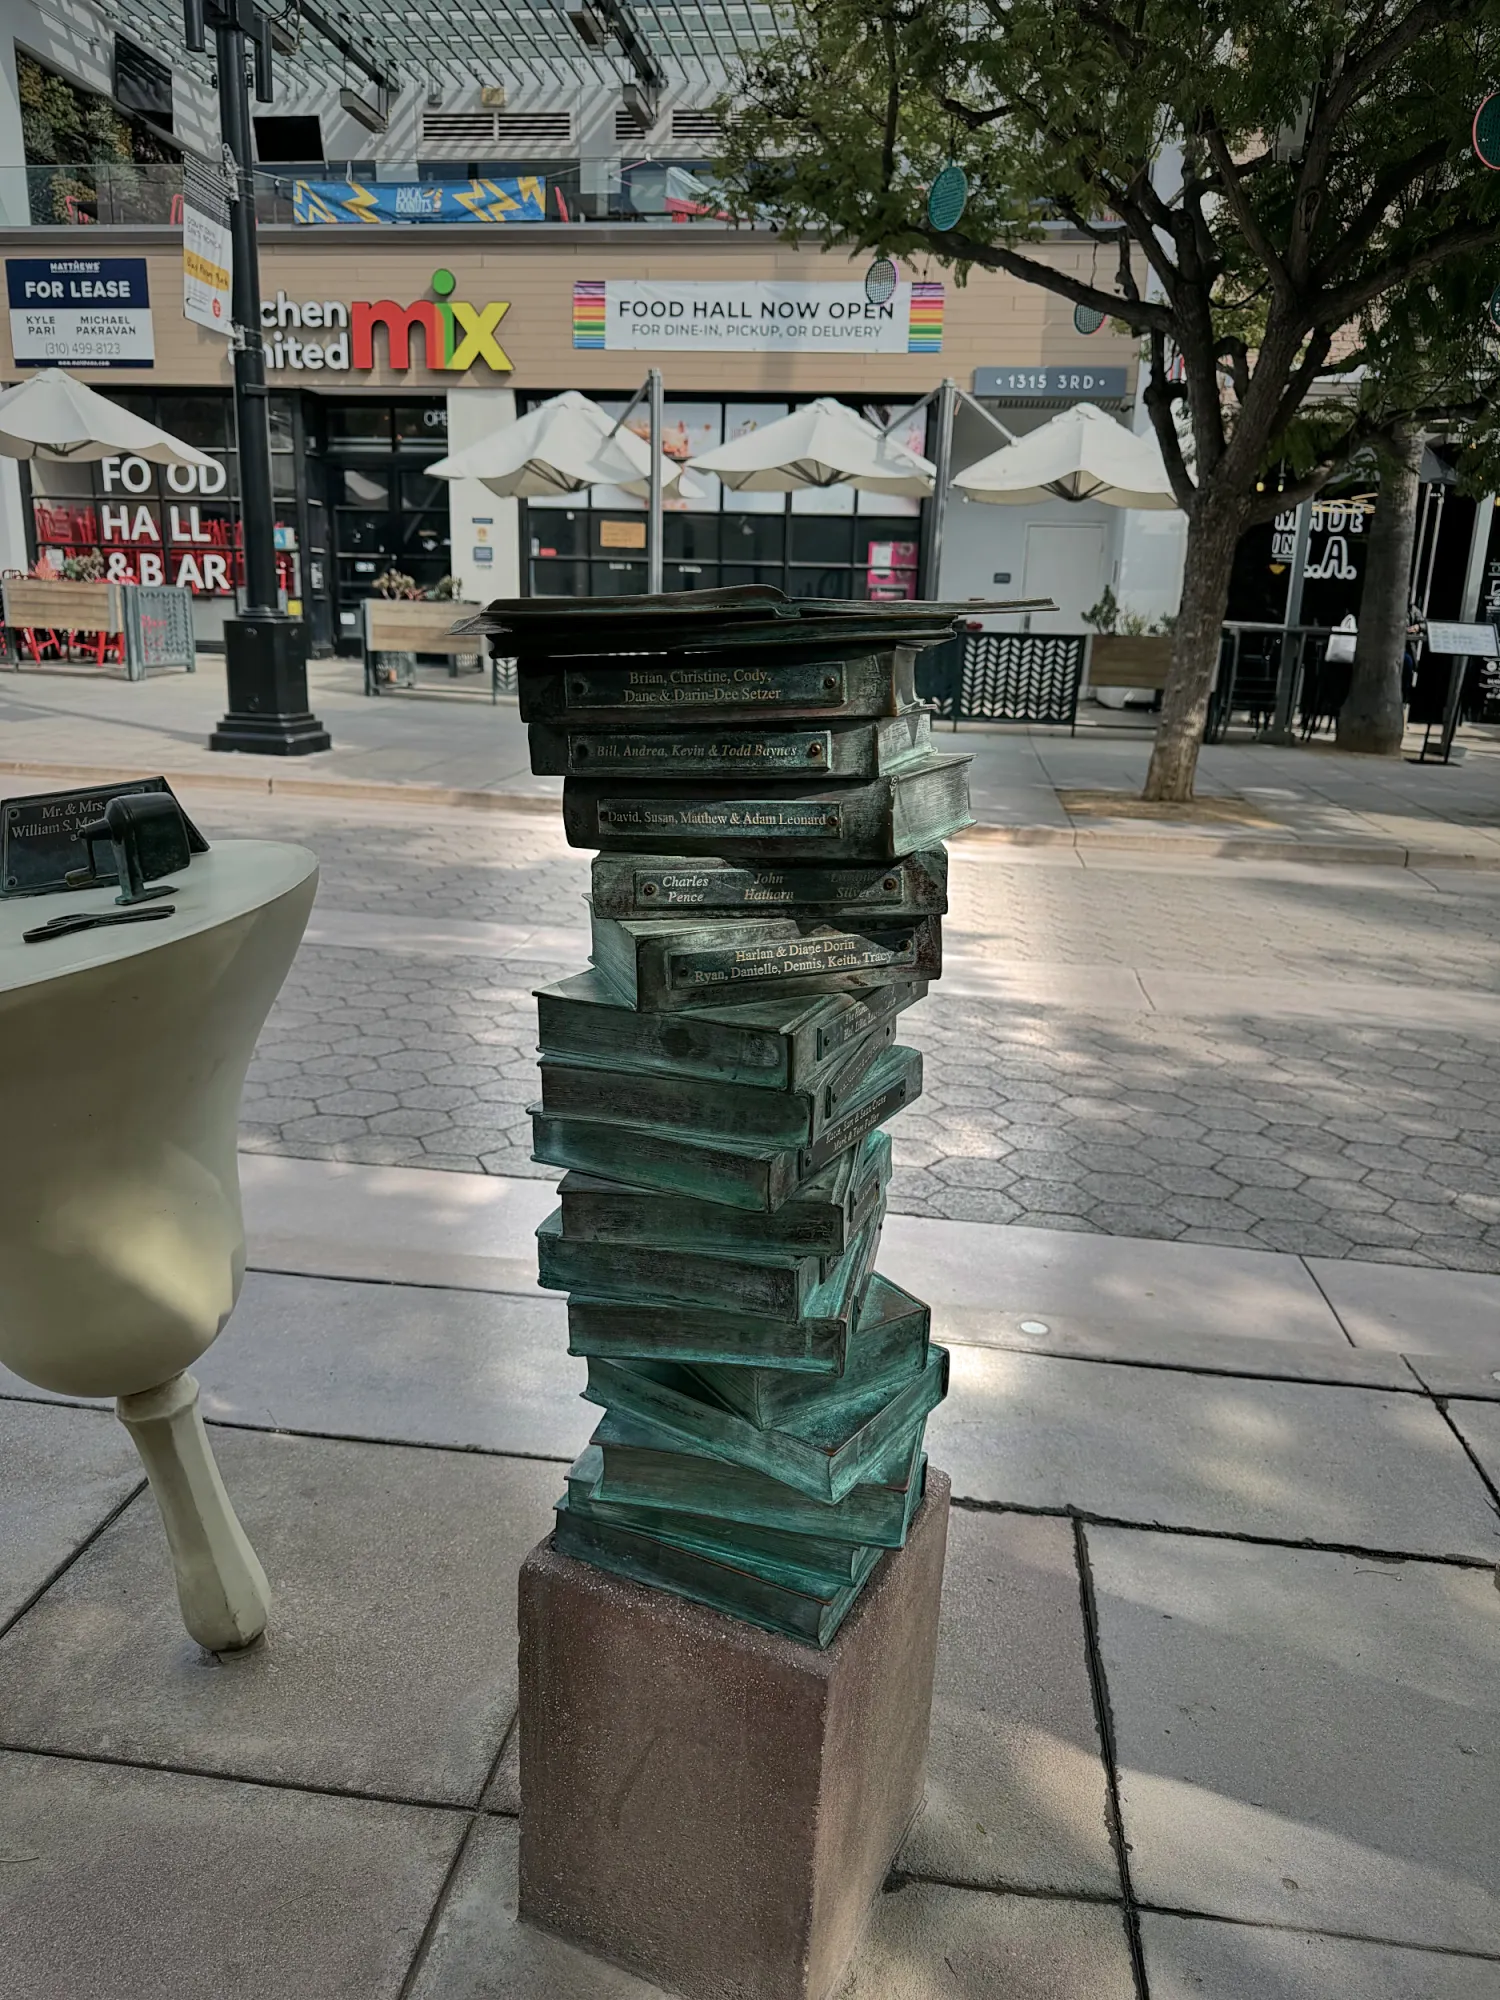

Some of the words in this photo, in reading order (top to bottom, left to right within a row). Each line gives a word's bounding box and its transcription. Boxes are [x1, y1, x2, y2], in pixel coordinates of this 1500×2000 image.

[396, 187, 422, 199] DUCK
[25, 281, 64, 298] FOR
[70, 281, 131, 298] LEASE
[259, 290, 349, 328] chen
[619, 301, 684, 318] FOOD
[693, 301, 752, 319] HALL
[761, 302, 820, 319] NOW
[829, 302, 894, 319] OPEN
[26, 316, 56, 324] KYLE
[80, 316, 131, 325] MICHAEL
[351, 268, 514, 371] mix
[28, 326, 56, 335] PARI
[76, 326, 137, 335] PAKRAVAN
[632, 324, 661, 336] FOR
[664, 324, 723, 337] DINE-IN,
[726, 325, 783, 338] PICKUP,
[786, 325, 807, 337] OR
[811, 325, 882, 338] DELIVERY
[45, 343, 69, 356] (310)
[72, 342, 121, 355] 499-8123
[228, 332, 350, 370] nited
[1008, 374, 1047, 389] 1315
[1058, 375, 1094, 389] 3RD
[424, 410, 448, 427] OPE
[101, 456, 227, 494] FOOD
[101, 504, 212, 542] HALL
[139, 552, 231, 589] BAR
[630, 671, 667, 686] Brian,
[670, 670, 731, 685] Christine,
[733, 668, 772, 684] Cody,
[623, 689, 656, 702] Dane
[659, 689, 671, 701] &
[674, 688, 738, 701] Darin-Dee
[741, 687, 781, 700] Setzer
[624, 745, 668, 757] Andrea,
[672, 744, 705, 757] Kevin
[708, 744, 719, 757] &
[721, 744, 750, 757] Todd
[754, 745, 797, 758] Baynes
[42, 805, 63, 819] Mr.
[65, 803, 77, 815] &
[79, 800, 105, 814] Mrs.
[608, 811, 642, 823] David,
[644, 812, 679, 824] Susan,
[679, 811, 727, 825] Matthew
[730, 812, 741, 825] &
[743, 813, 777, 825] Adam
[779, 813, 827, 826] Leonard
[12, 823, 60, 838] William
[62, 819, 73, 831] S.
[662, 876, 709, 887] Charles
[754, 872, 783, 885] John
[668, 891, 704, 902] Pence
[735, 949, 774, 962] Harlan
[776, 946, 787, 958] &
[789, 943, 822, 957] Diane
[823, 940, 856, 952] Dorin
[694, 970, 729, 984] Ryan,
[731, 962, 781, 979] Danielle,
[783, 959, 825, 973] Dennis,
[827, 953, 861, 967] Keith,
[862, 950, 895, 964] Tracy
